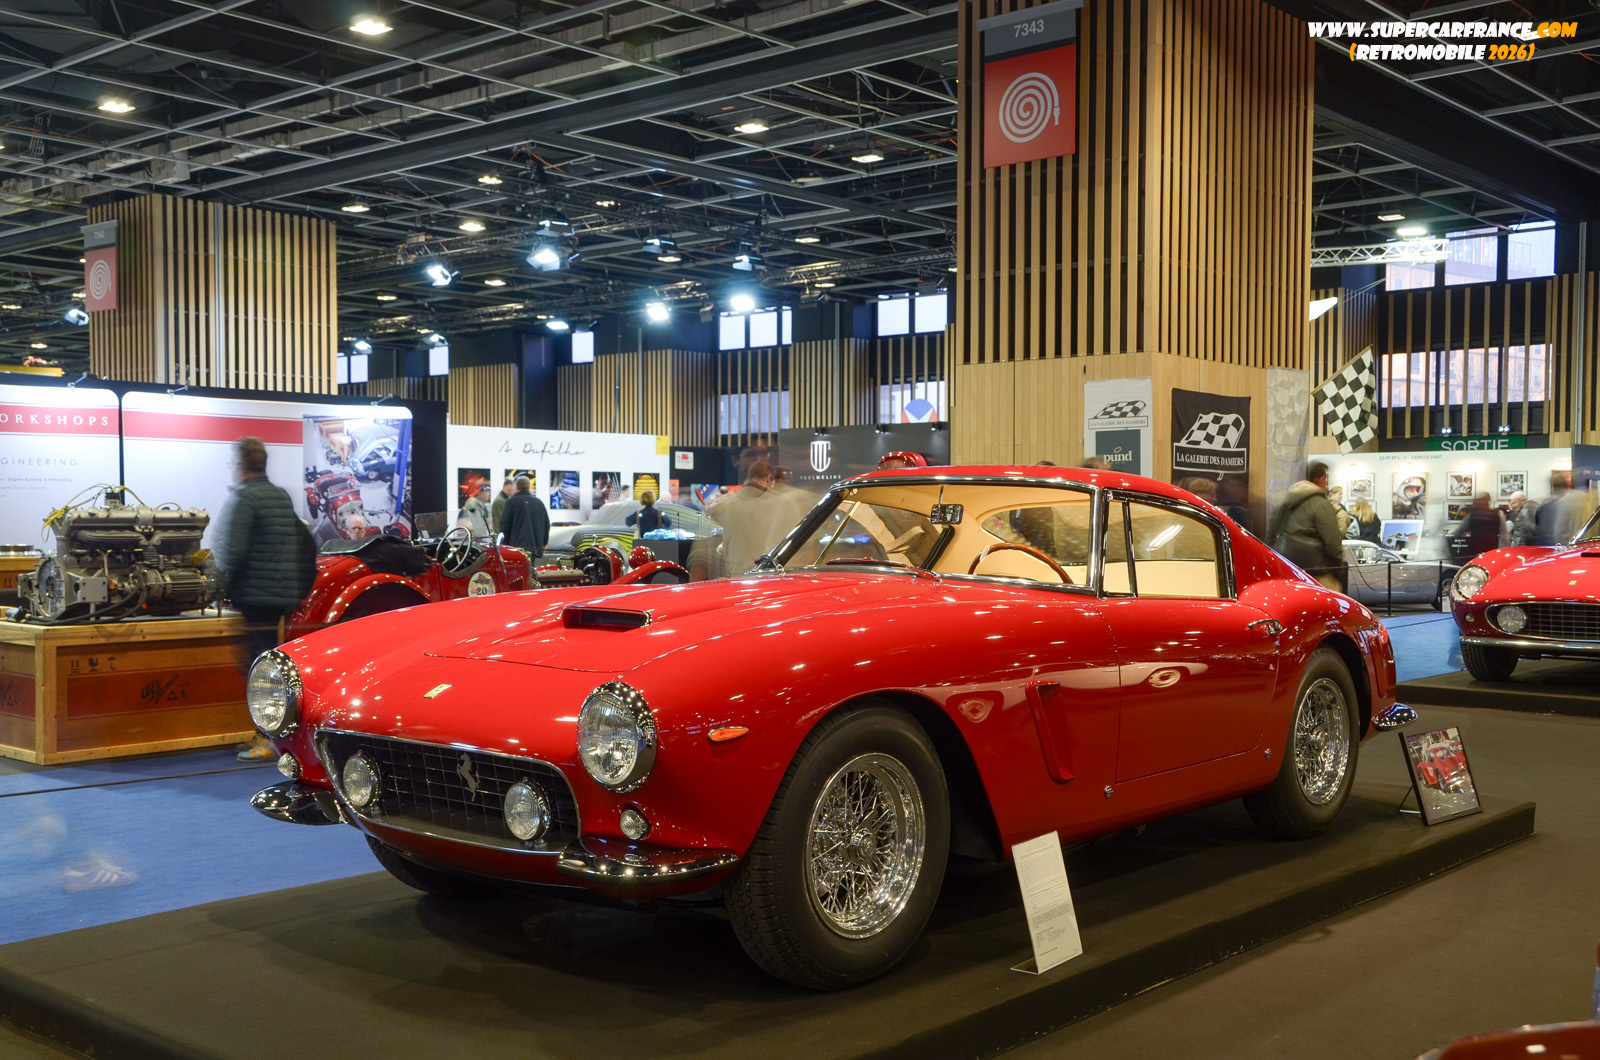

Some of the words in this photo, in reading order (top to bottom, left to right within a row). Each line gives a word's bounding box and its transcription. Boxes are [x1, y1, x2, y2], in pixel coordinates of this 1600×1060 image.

[1014, 19, 1045, 38] 7343
[0, 413, 109, 426] ORKSHOPS
[1441, 439, 1509, 451] SORTIE
[0, 457, 77, 466] GINEERING
[1176, 452, 1185, 462] LA
[1185, 453, 1209, 464] GALERIE
[1209, 455, 1220, 465] DES
[1220, 457, 1244, 466] DAMIERS
[476, 587, 488, 596] 20
